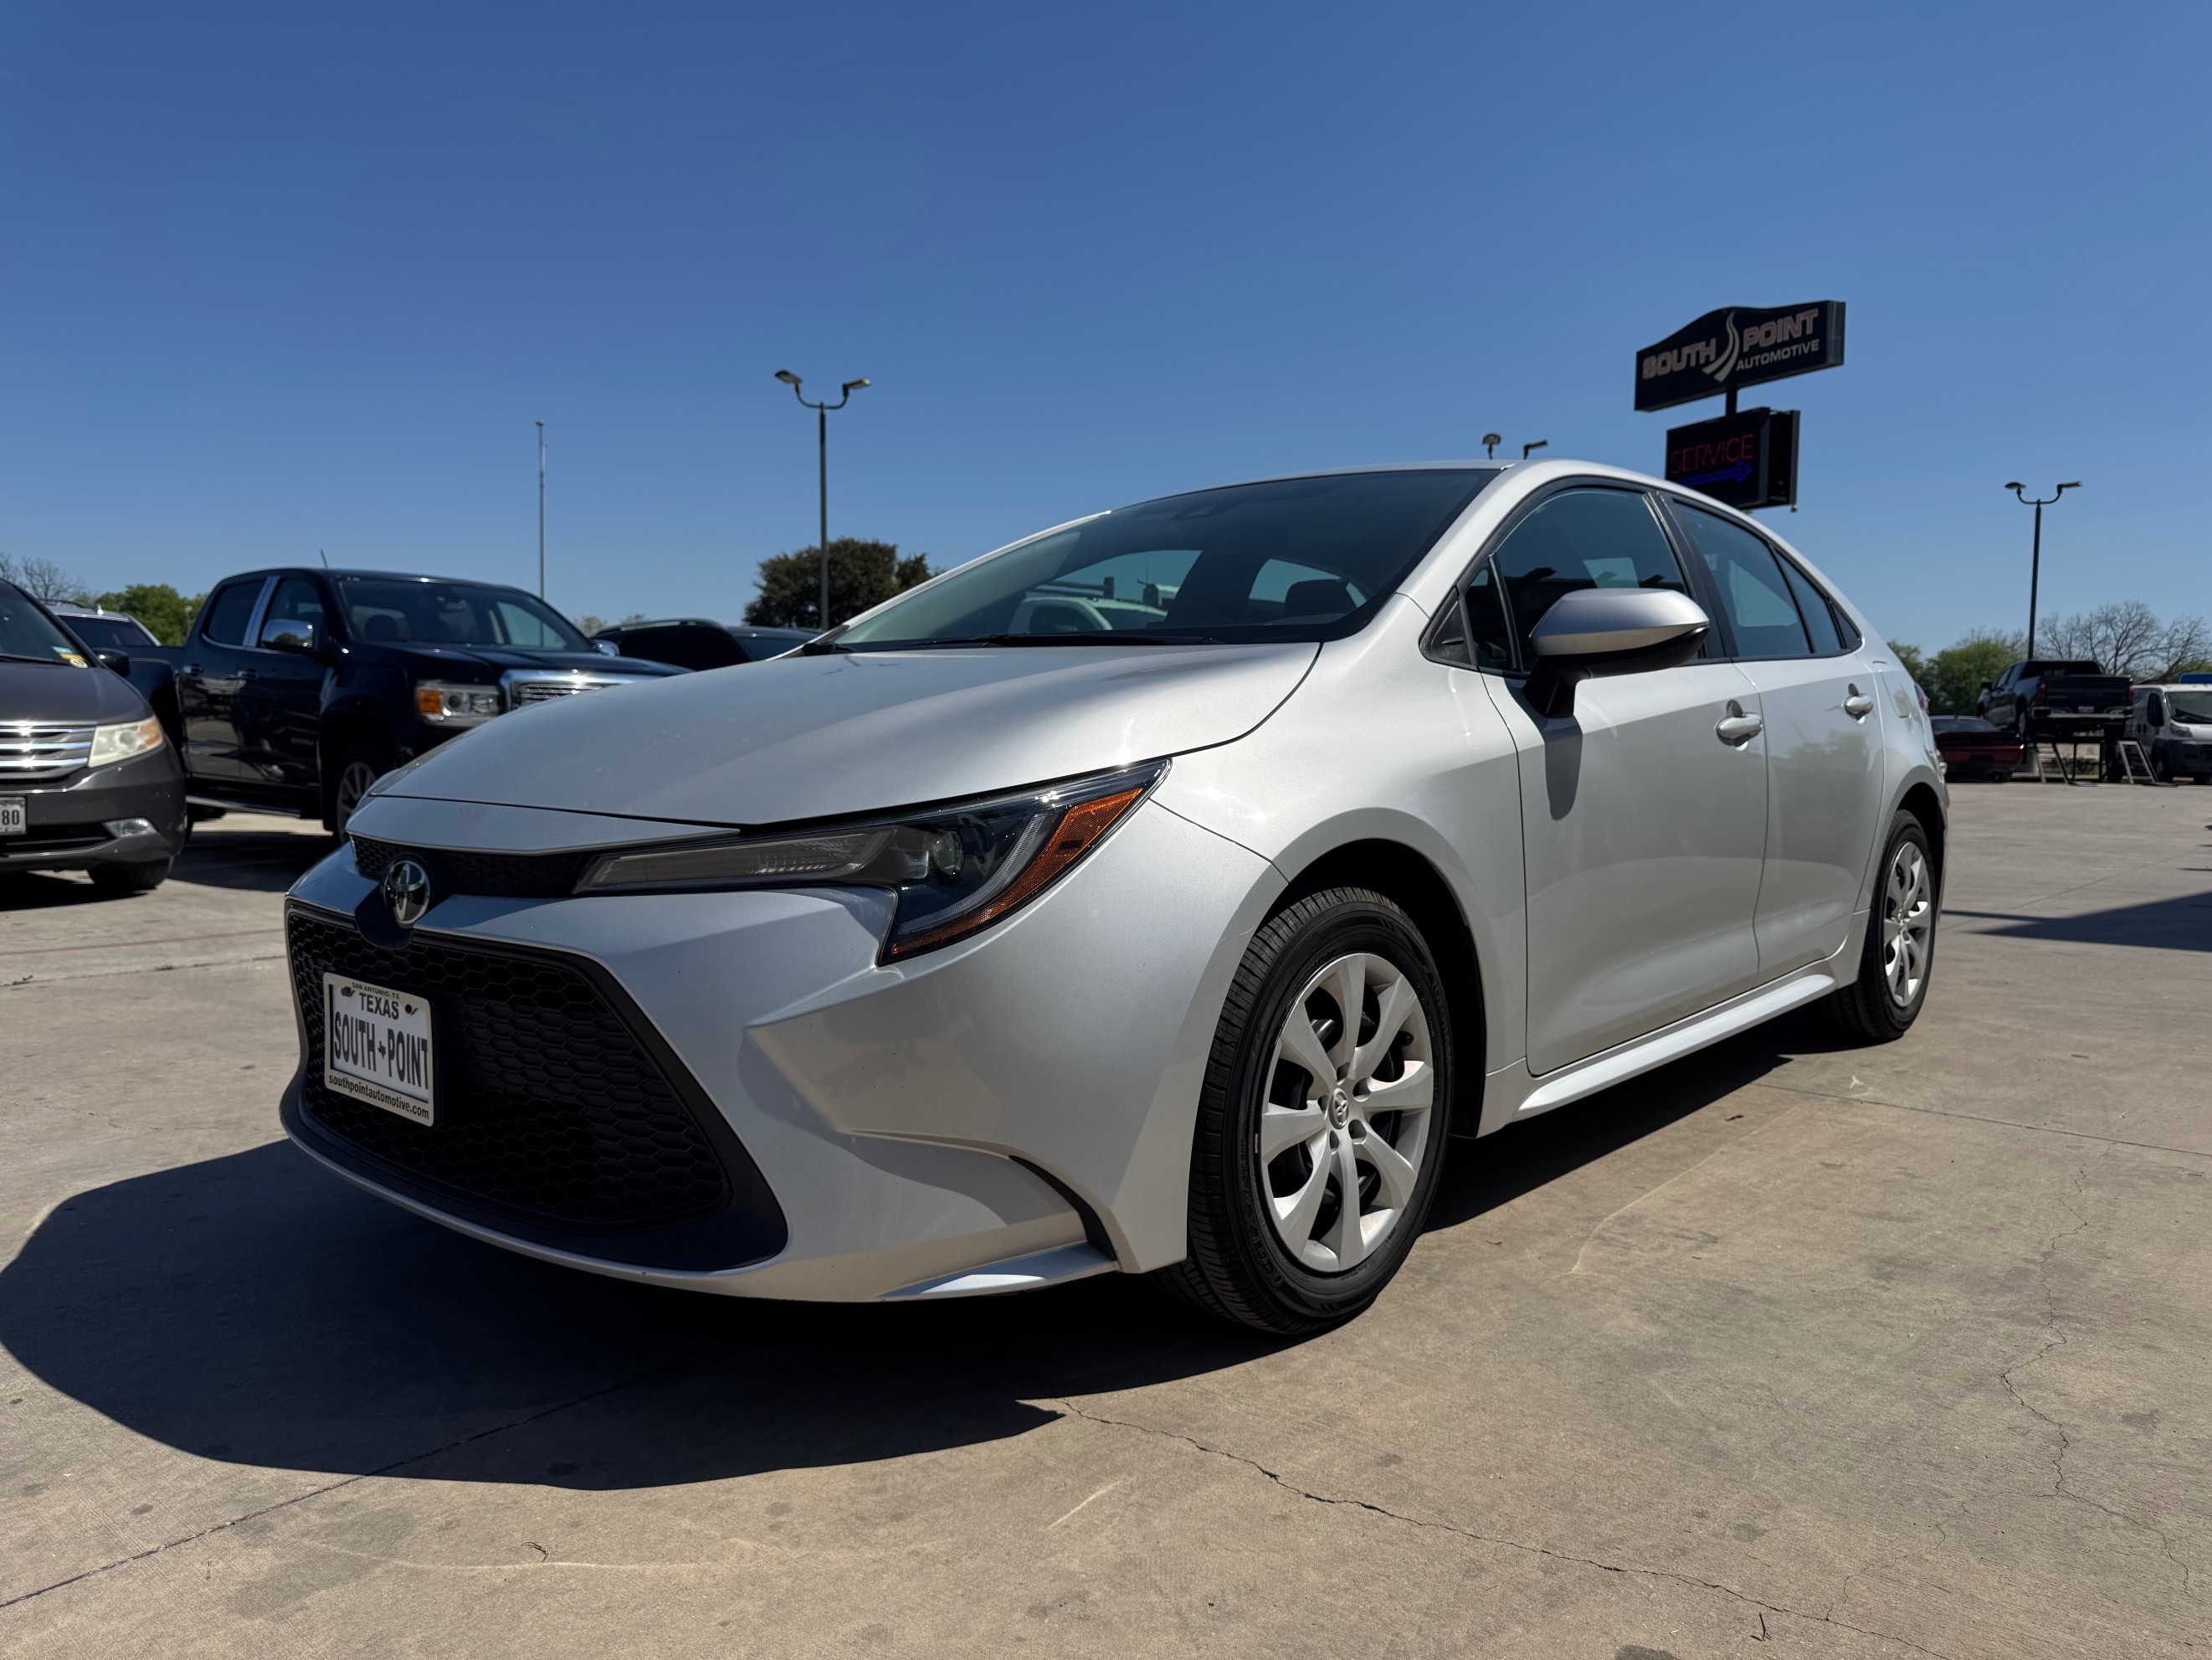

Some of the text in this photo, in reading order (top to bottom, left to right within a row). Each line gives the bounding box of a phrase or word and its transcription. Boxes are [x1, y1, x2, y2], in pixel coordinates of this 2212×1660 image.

[1642, 308, 1819, 380] SOUTH POINT
[1735, 338, 1820, 373] AUTOMOTIVE
[1670, 433, 1755, 474] SERVICE
[352, 982, 363, 990] SAN
[359, 992, 400, 1020] TEXAS
[335, 1010, 429, 1090] SOUTH POINT
[329, 1075, 429, 1120] southpointautomotive.com
